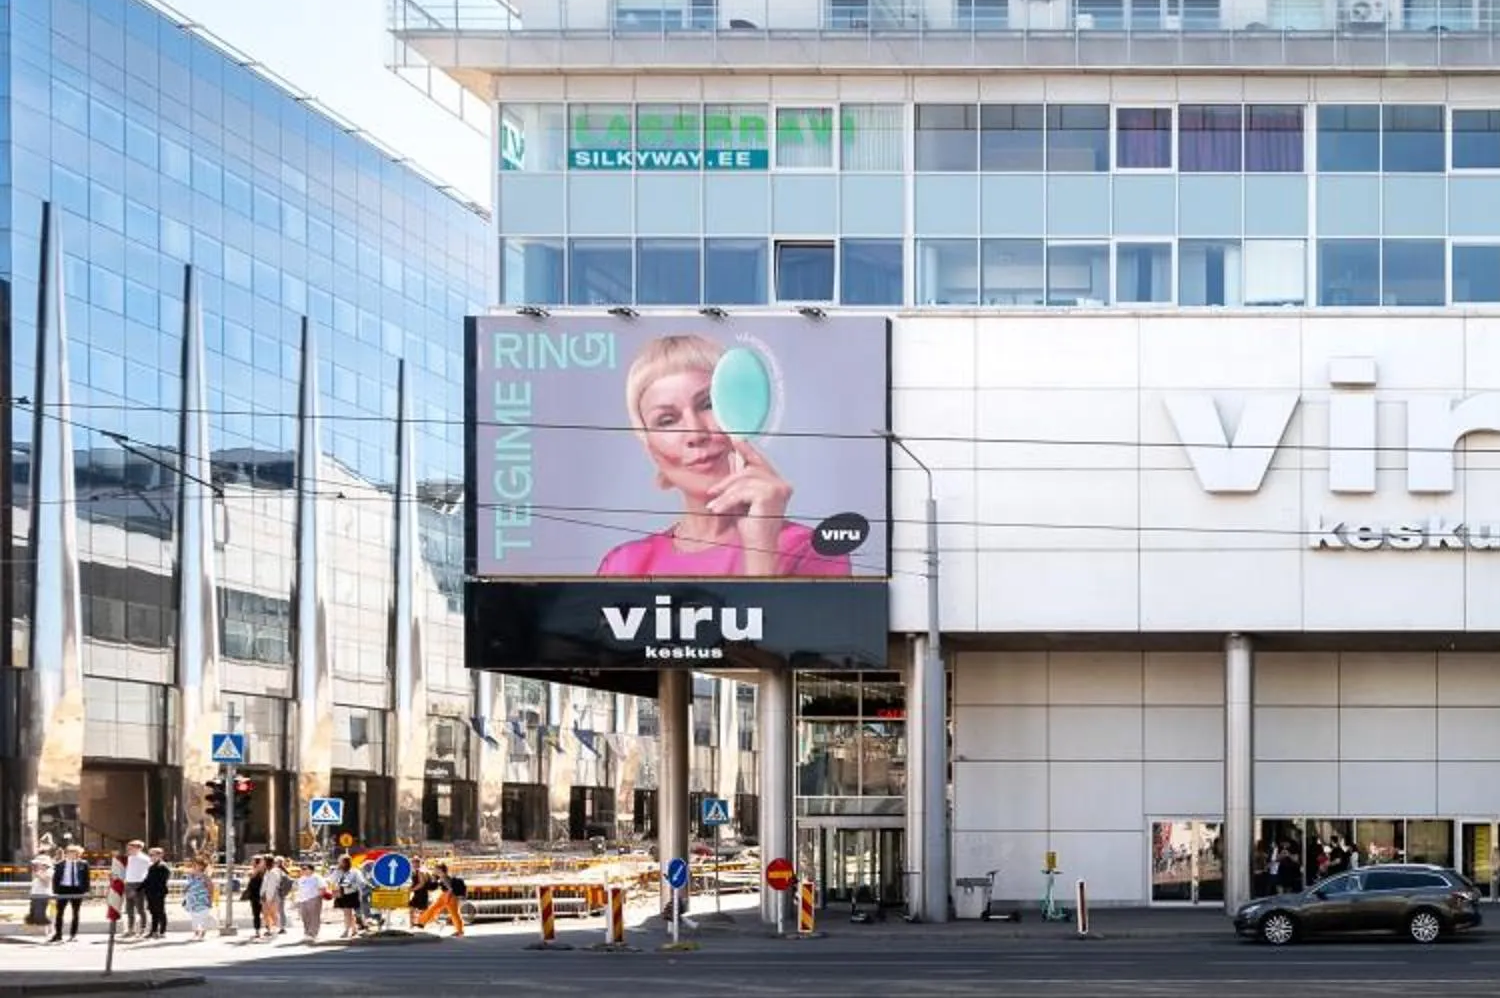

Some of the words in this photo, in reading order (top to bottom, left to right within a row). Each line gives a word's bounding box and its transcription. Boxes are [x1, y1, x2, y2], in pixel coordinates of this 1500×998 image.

[575, 151, 751, 167] SILKYWAY.EE
[494, 331, 616, 369] RINGI
[494, 380, 532, 559] TEGIME
[821, 529, 861, 541] viru
[601, 595, 764, 641] viru
[645, 645, 723, 659] keskus
